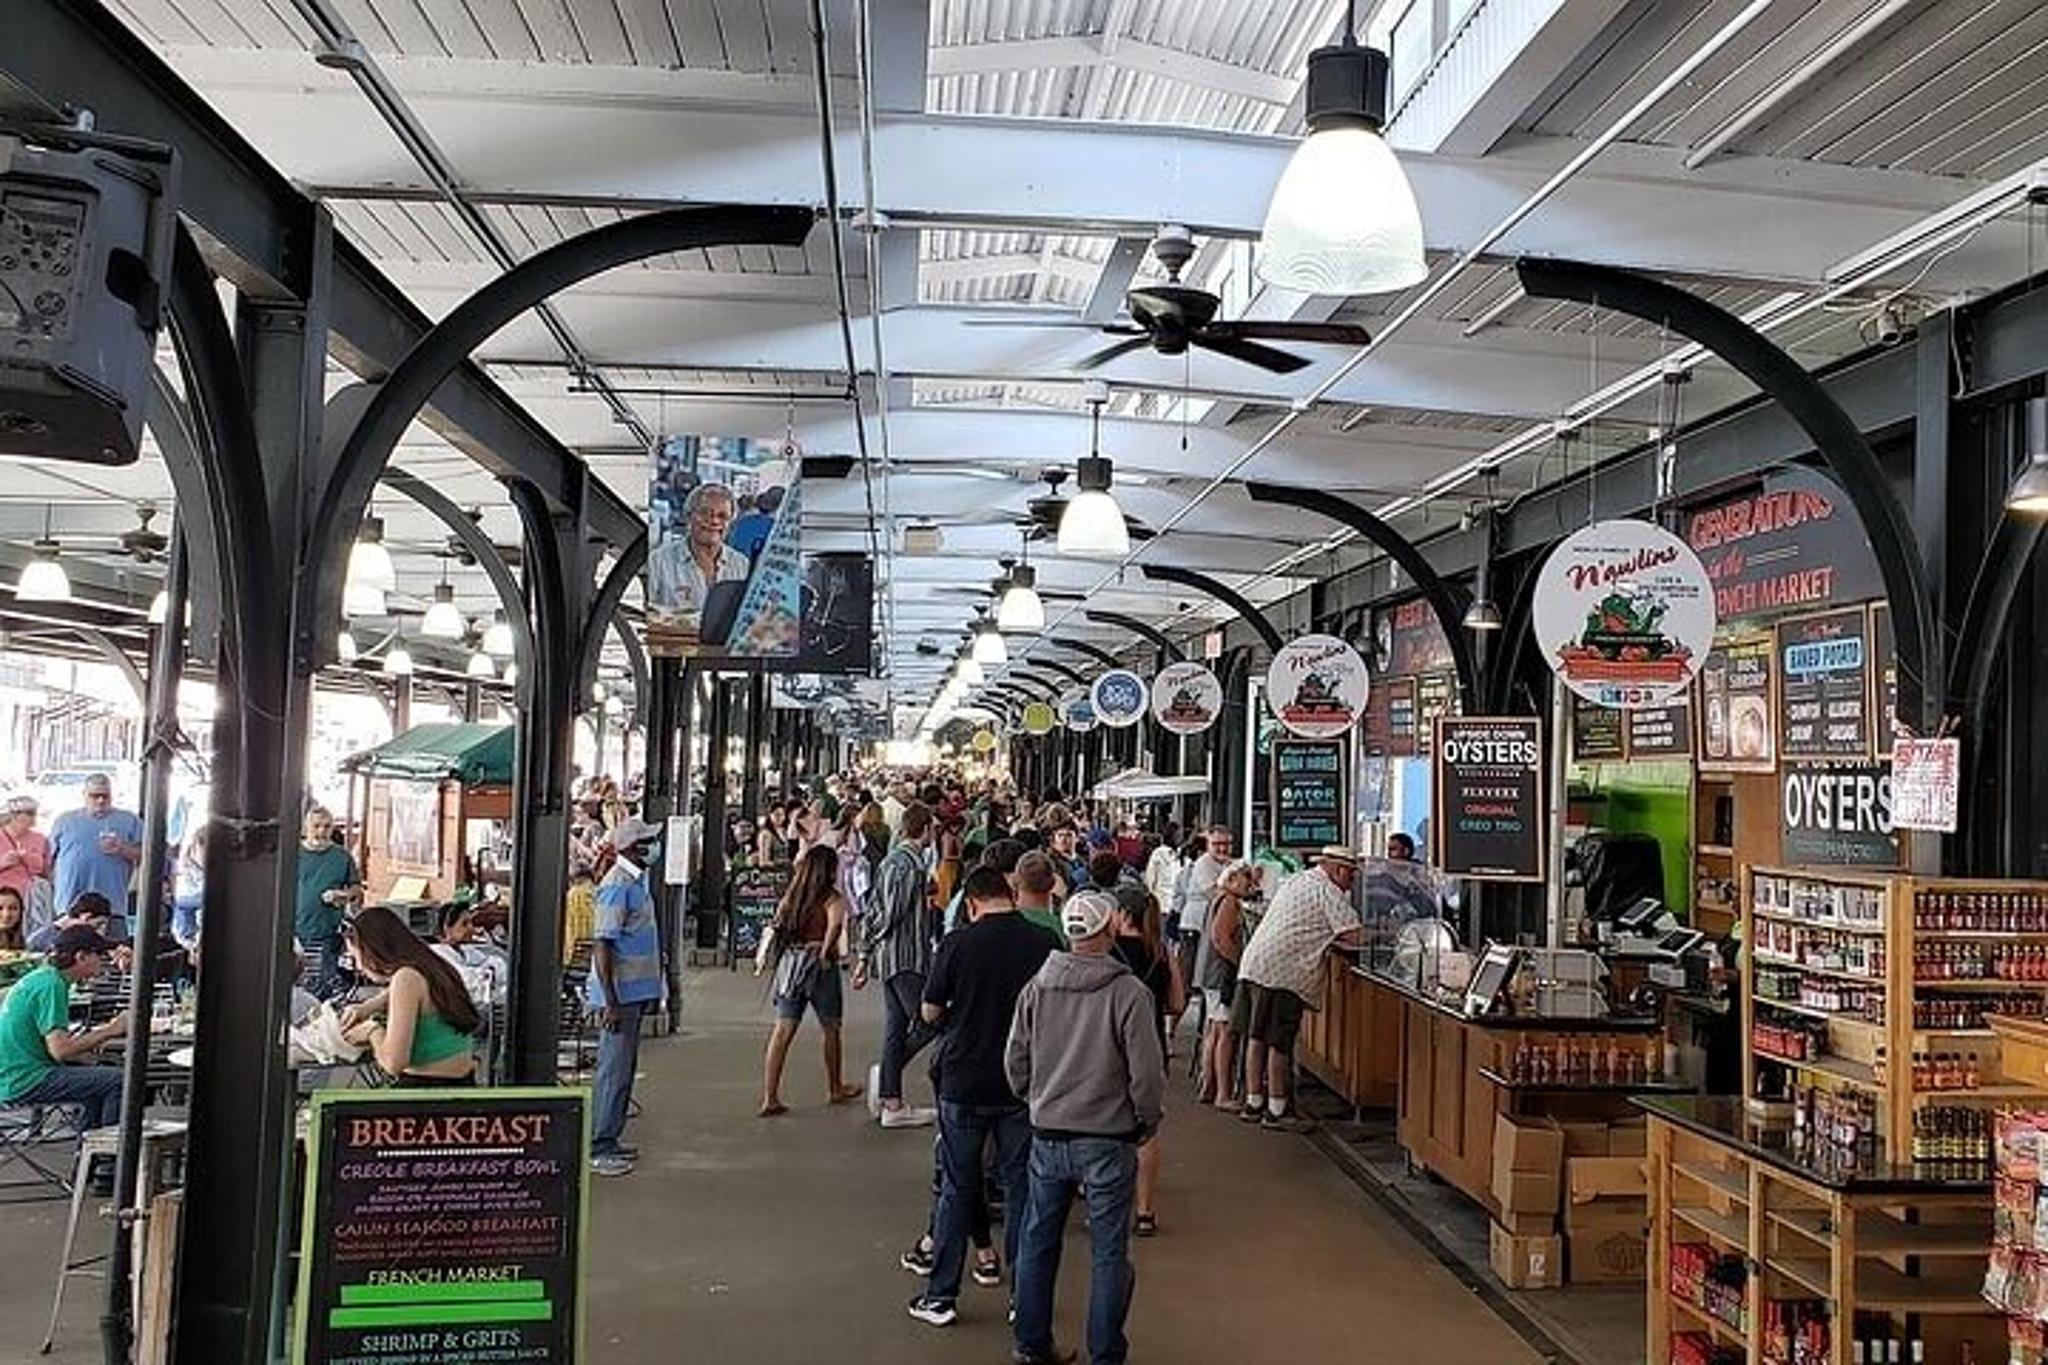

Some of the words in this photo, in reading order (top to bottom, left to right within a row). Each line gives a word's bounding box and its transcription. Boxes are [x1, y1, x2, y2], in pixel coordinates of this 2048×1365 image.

[1717, 584, 1757, 616] ENCH
[1762, 566, 1833, 606] MARKET
[1789, 646, 1821, 669] BAKED
[1822, 641, 1860, 667] POTATO
[1444, 741, 1538, 763] OYSTERS
[1785, 773, 1895, 834] OYSTERS
[351, 1115, 550, 1147] BREAKFAST
[340, 1163, 408, 1180] CREOLE
[412, 1160, 511, 1178] BREAKFAST
[514, 1160, 561, 1176] BOWL
[335, 1222, 388, 1238] CAJUN
[394, 1216, 467, 1237] SEAFOOD
[471, 1216, 560, 1232] BREAKFAST
[367, 1269, 442, 1285] FRENCH
[447, 1264, 524, 1283] MARKET
[361, 1333, 439, 1353] SHRIMP
[442, 1331, 459, 1349] &
[462, 1330, 521, 1347] GRITS
